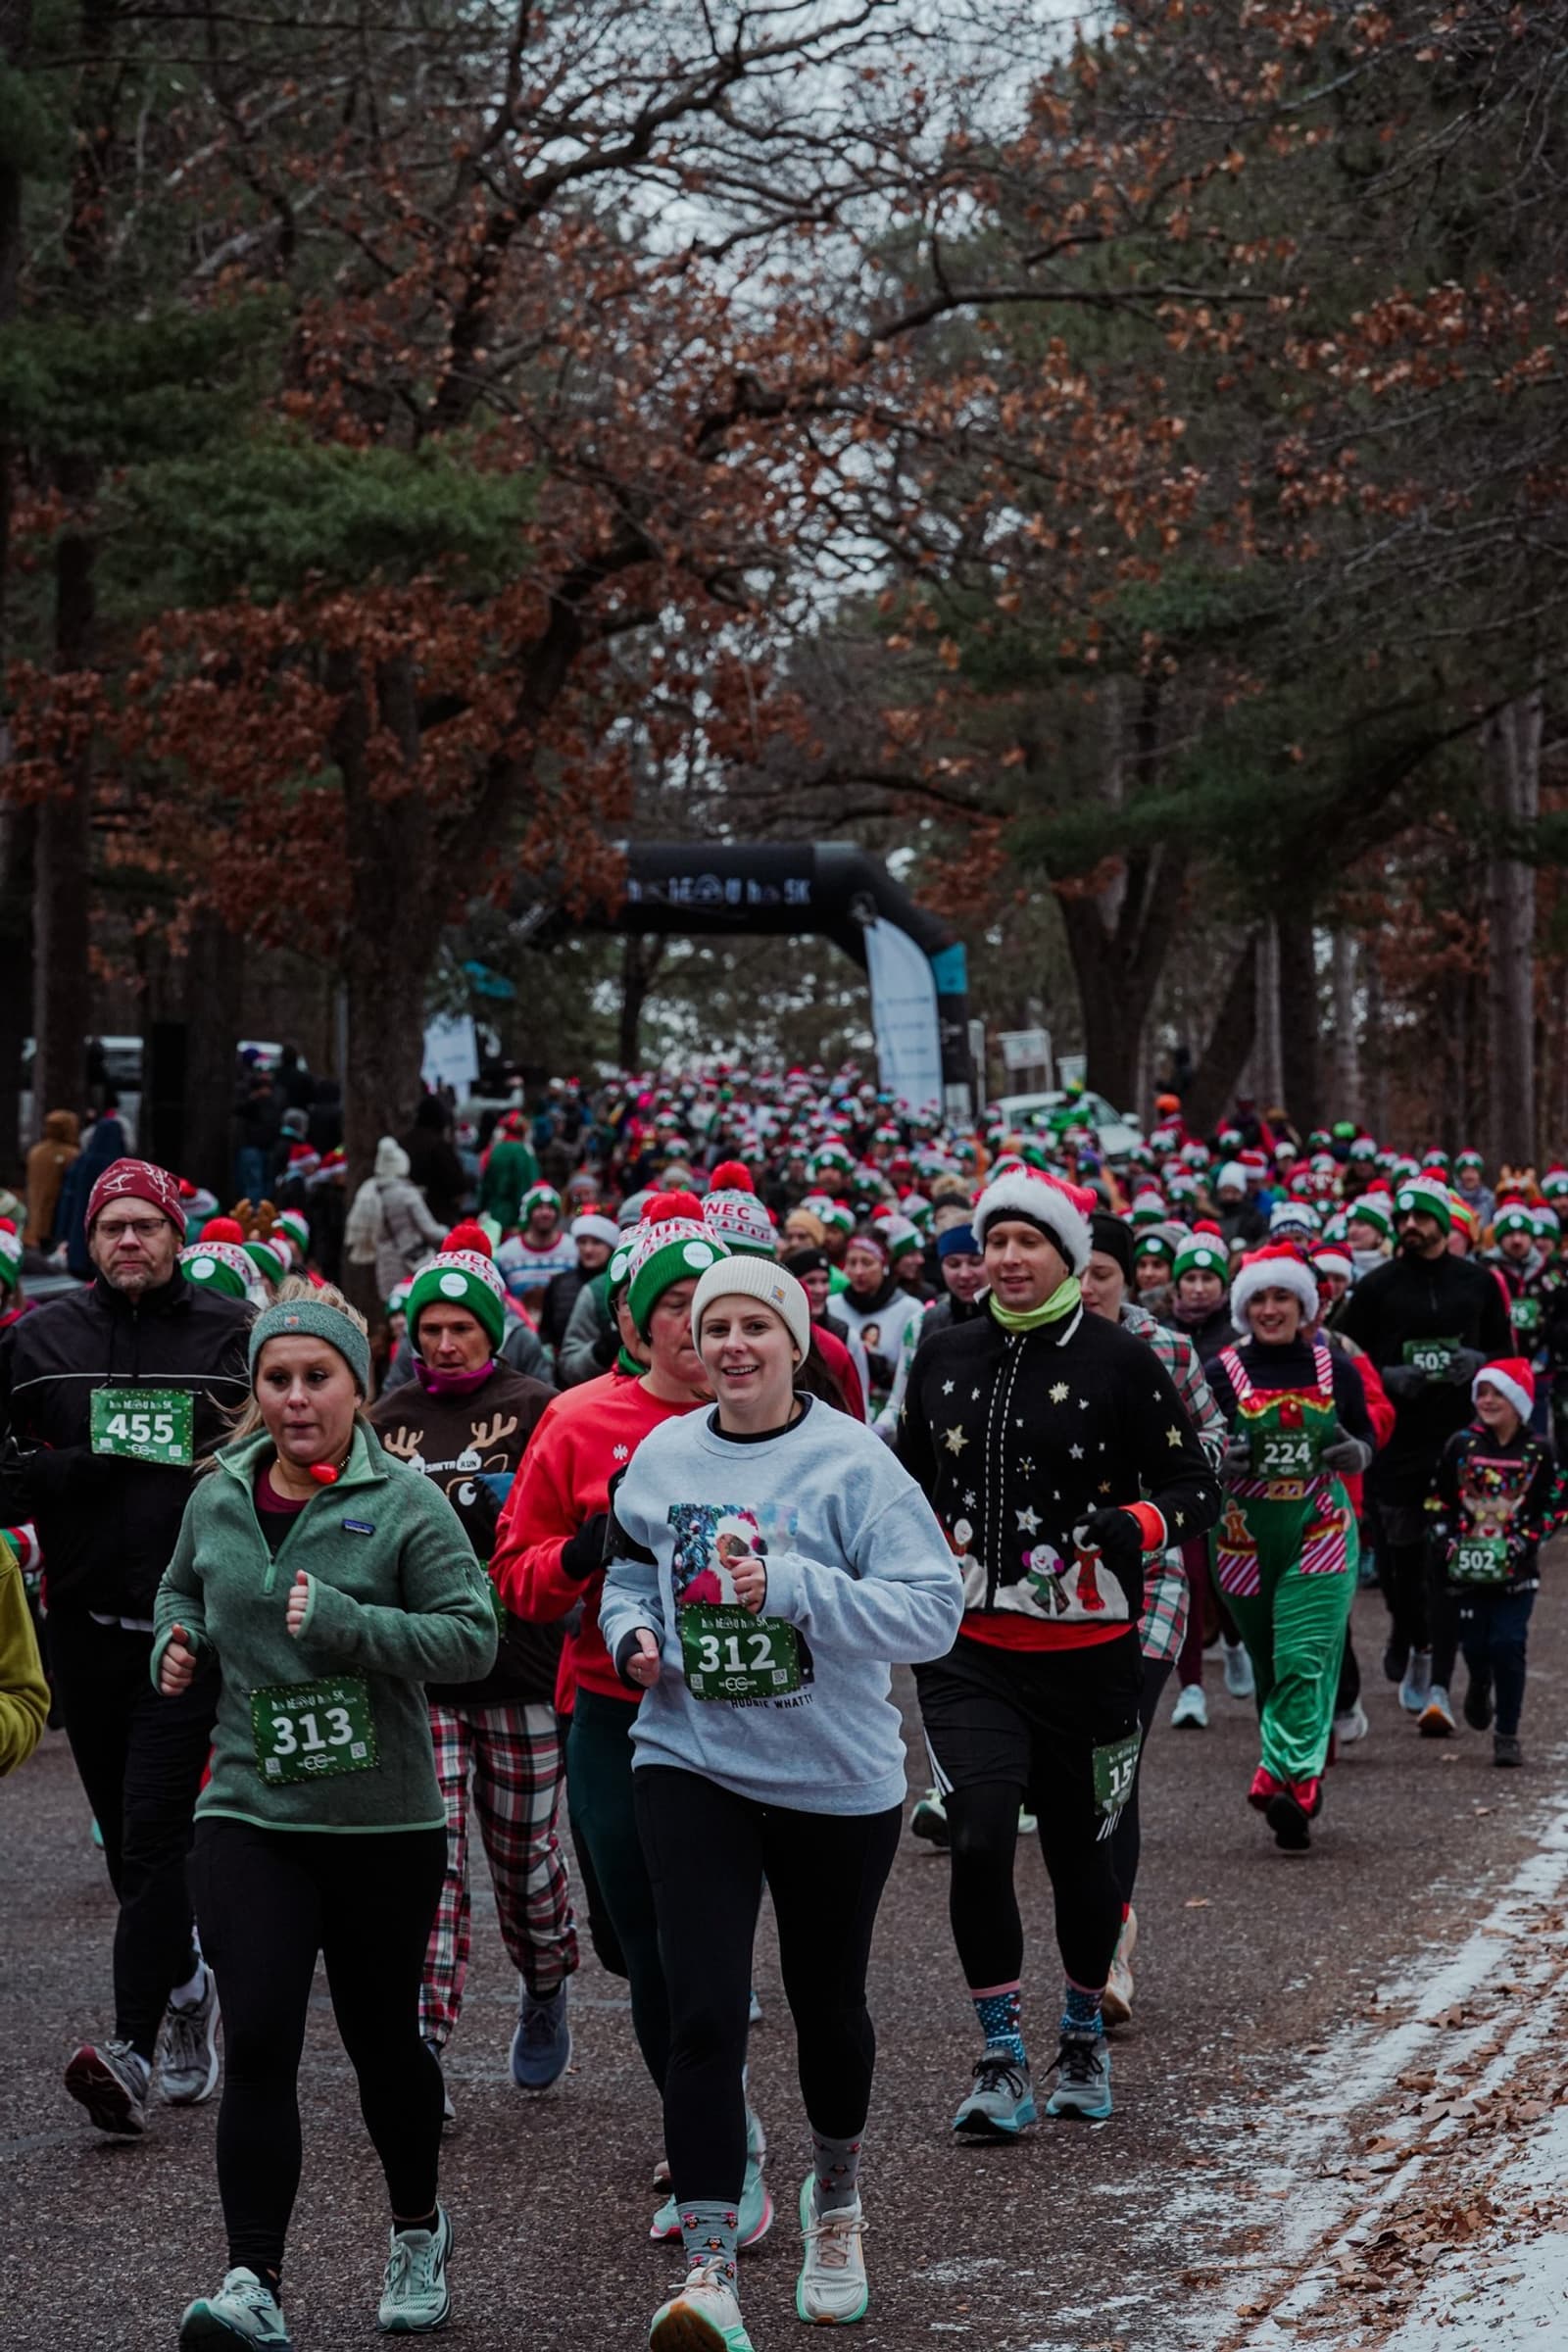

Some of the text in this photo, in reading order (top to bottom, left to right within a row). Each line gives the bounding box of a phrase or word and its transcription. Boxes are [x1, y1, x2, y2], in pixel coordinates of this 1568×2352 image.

[703, 1201, 751, 1221] NEC
[106, 1413, 174, 1444] 455
[1263, 1442, 1311, 1463] 224
[1458, 1549, 1496, 1571] 502
[698, 1633, 776, 1673] 312
[270, 1707, 354, 1755] 313
[1108, 1752, 1139, 1796] 15
